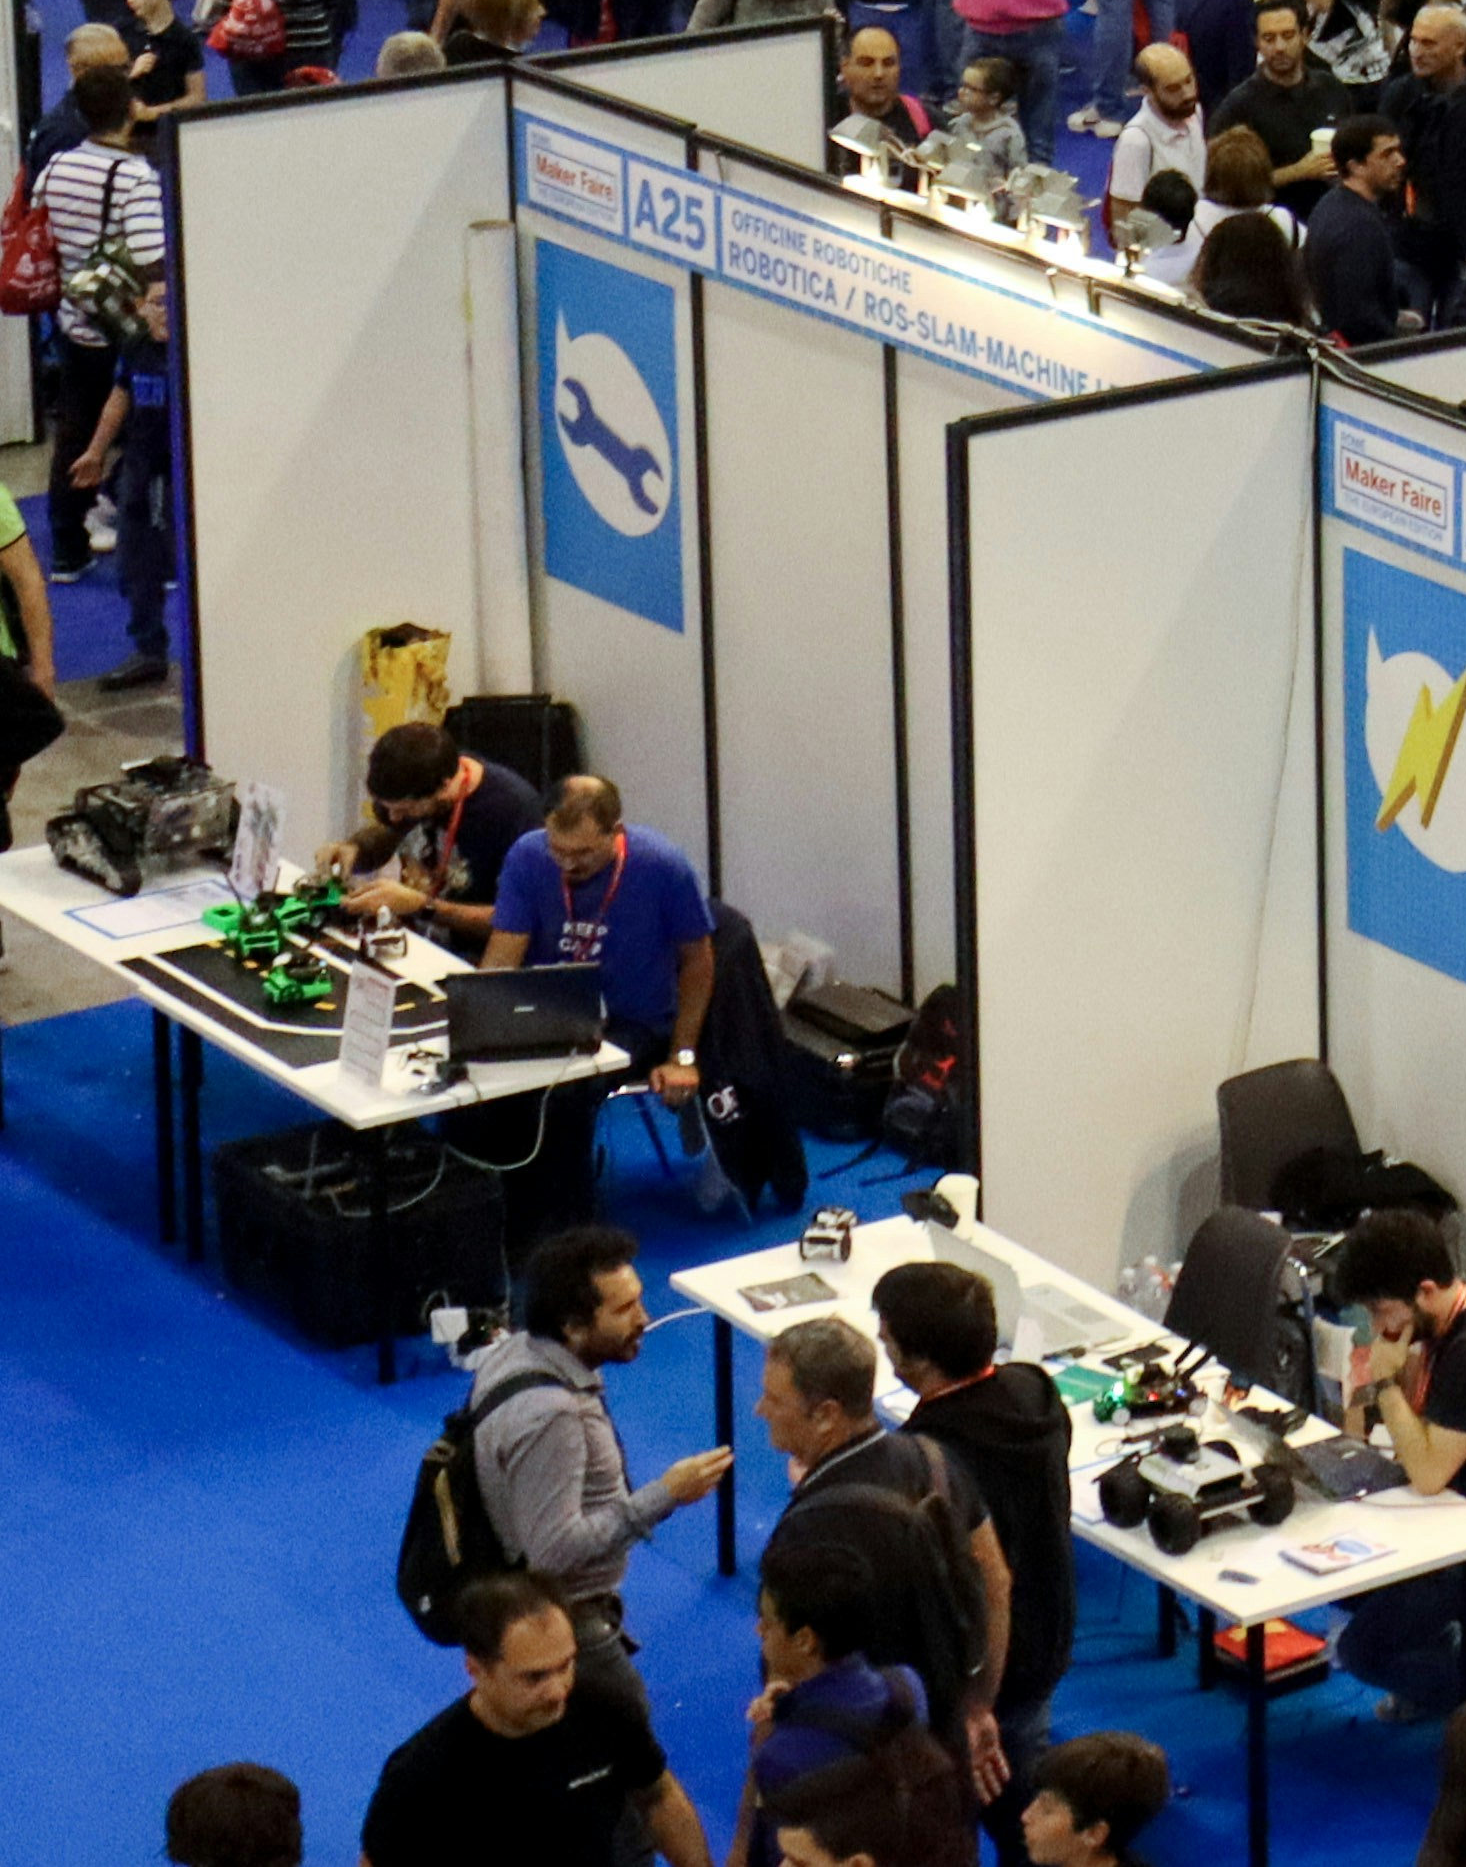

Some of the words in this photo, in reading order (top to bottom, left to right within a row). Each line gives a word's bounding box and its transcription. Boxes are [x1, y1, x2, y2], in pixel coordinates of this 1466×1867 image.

[535, 153, 578, 188] Maker
[580, 171, 615, 203] Faire
[634, 179, 706, 252] A25
[731, 208, 808, 257] OFFICINE
[811, 238, 913, 295] ROBOTICHE
[728, 240, 839, 307] ROBOTICA
[864, 290, 1088, 397] ROS-SLAM-MACHINE
[1345, 456, 1396, 501] Maker
[1401, 478, 1443, 518] Faire
